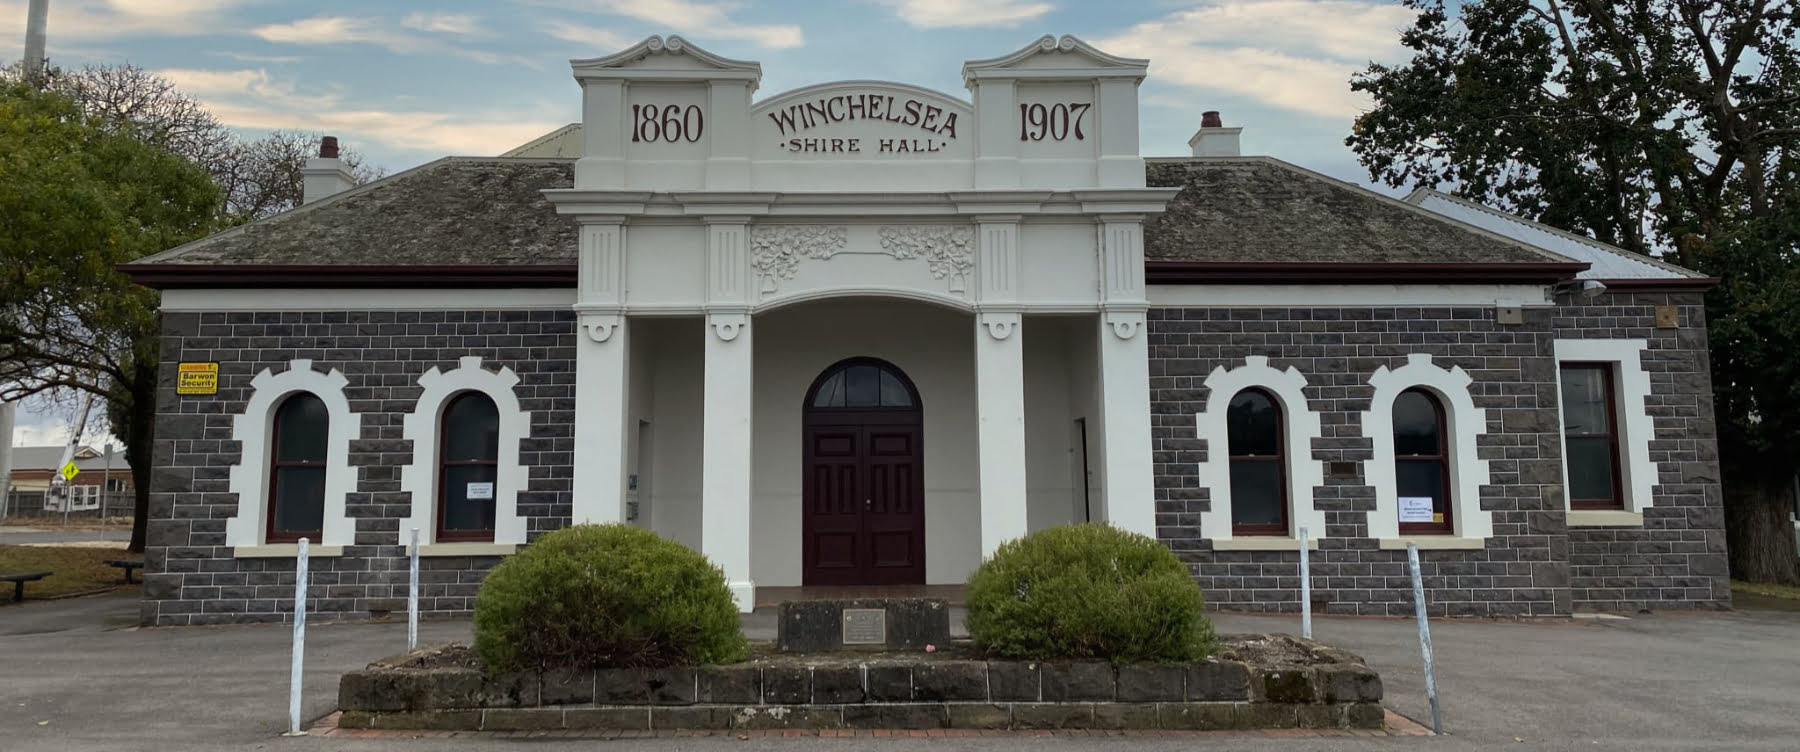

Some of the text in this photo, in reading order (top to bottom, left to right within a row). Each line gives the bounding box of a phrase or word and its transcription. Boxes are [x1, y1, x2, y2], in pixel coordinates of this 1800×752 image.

[632, 104, 704, 143] 1860
[768, 94, 957, 139] WINCHELSEA
[1020, 103, 1091, 141] 1907
